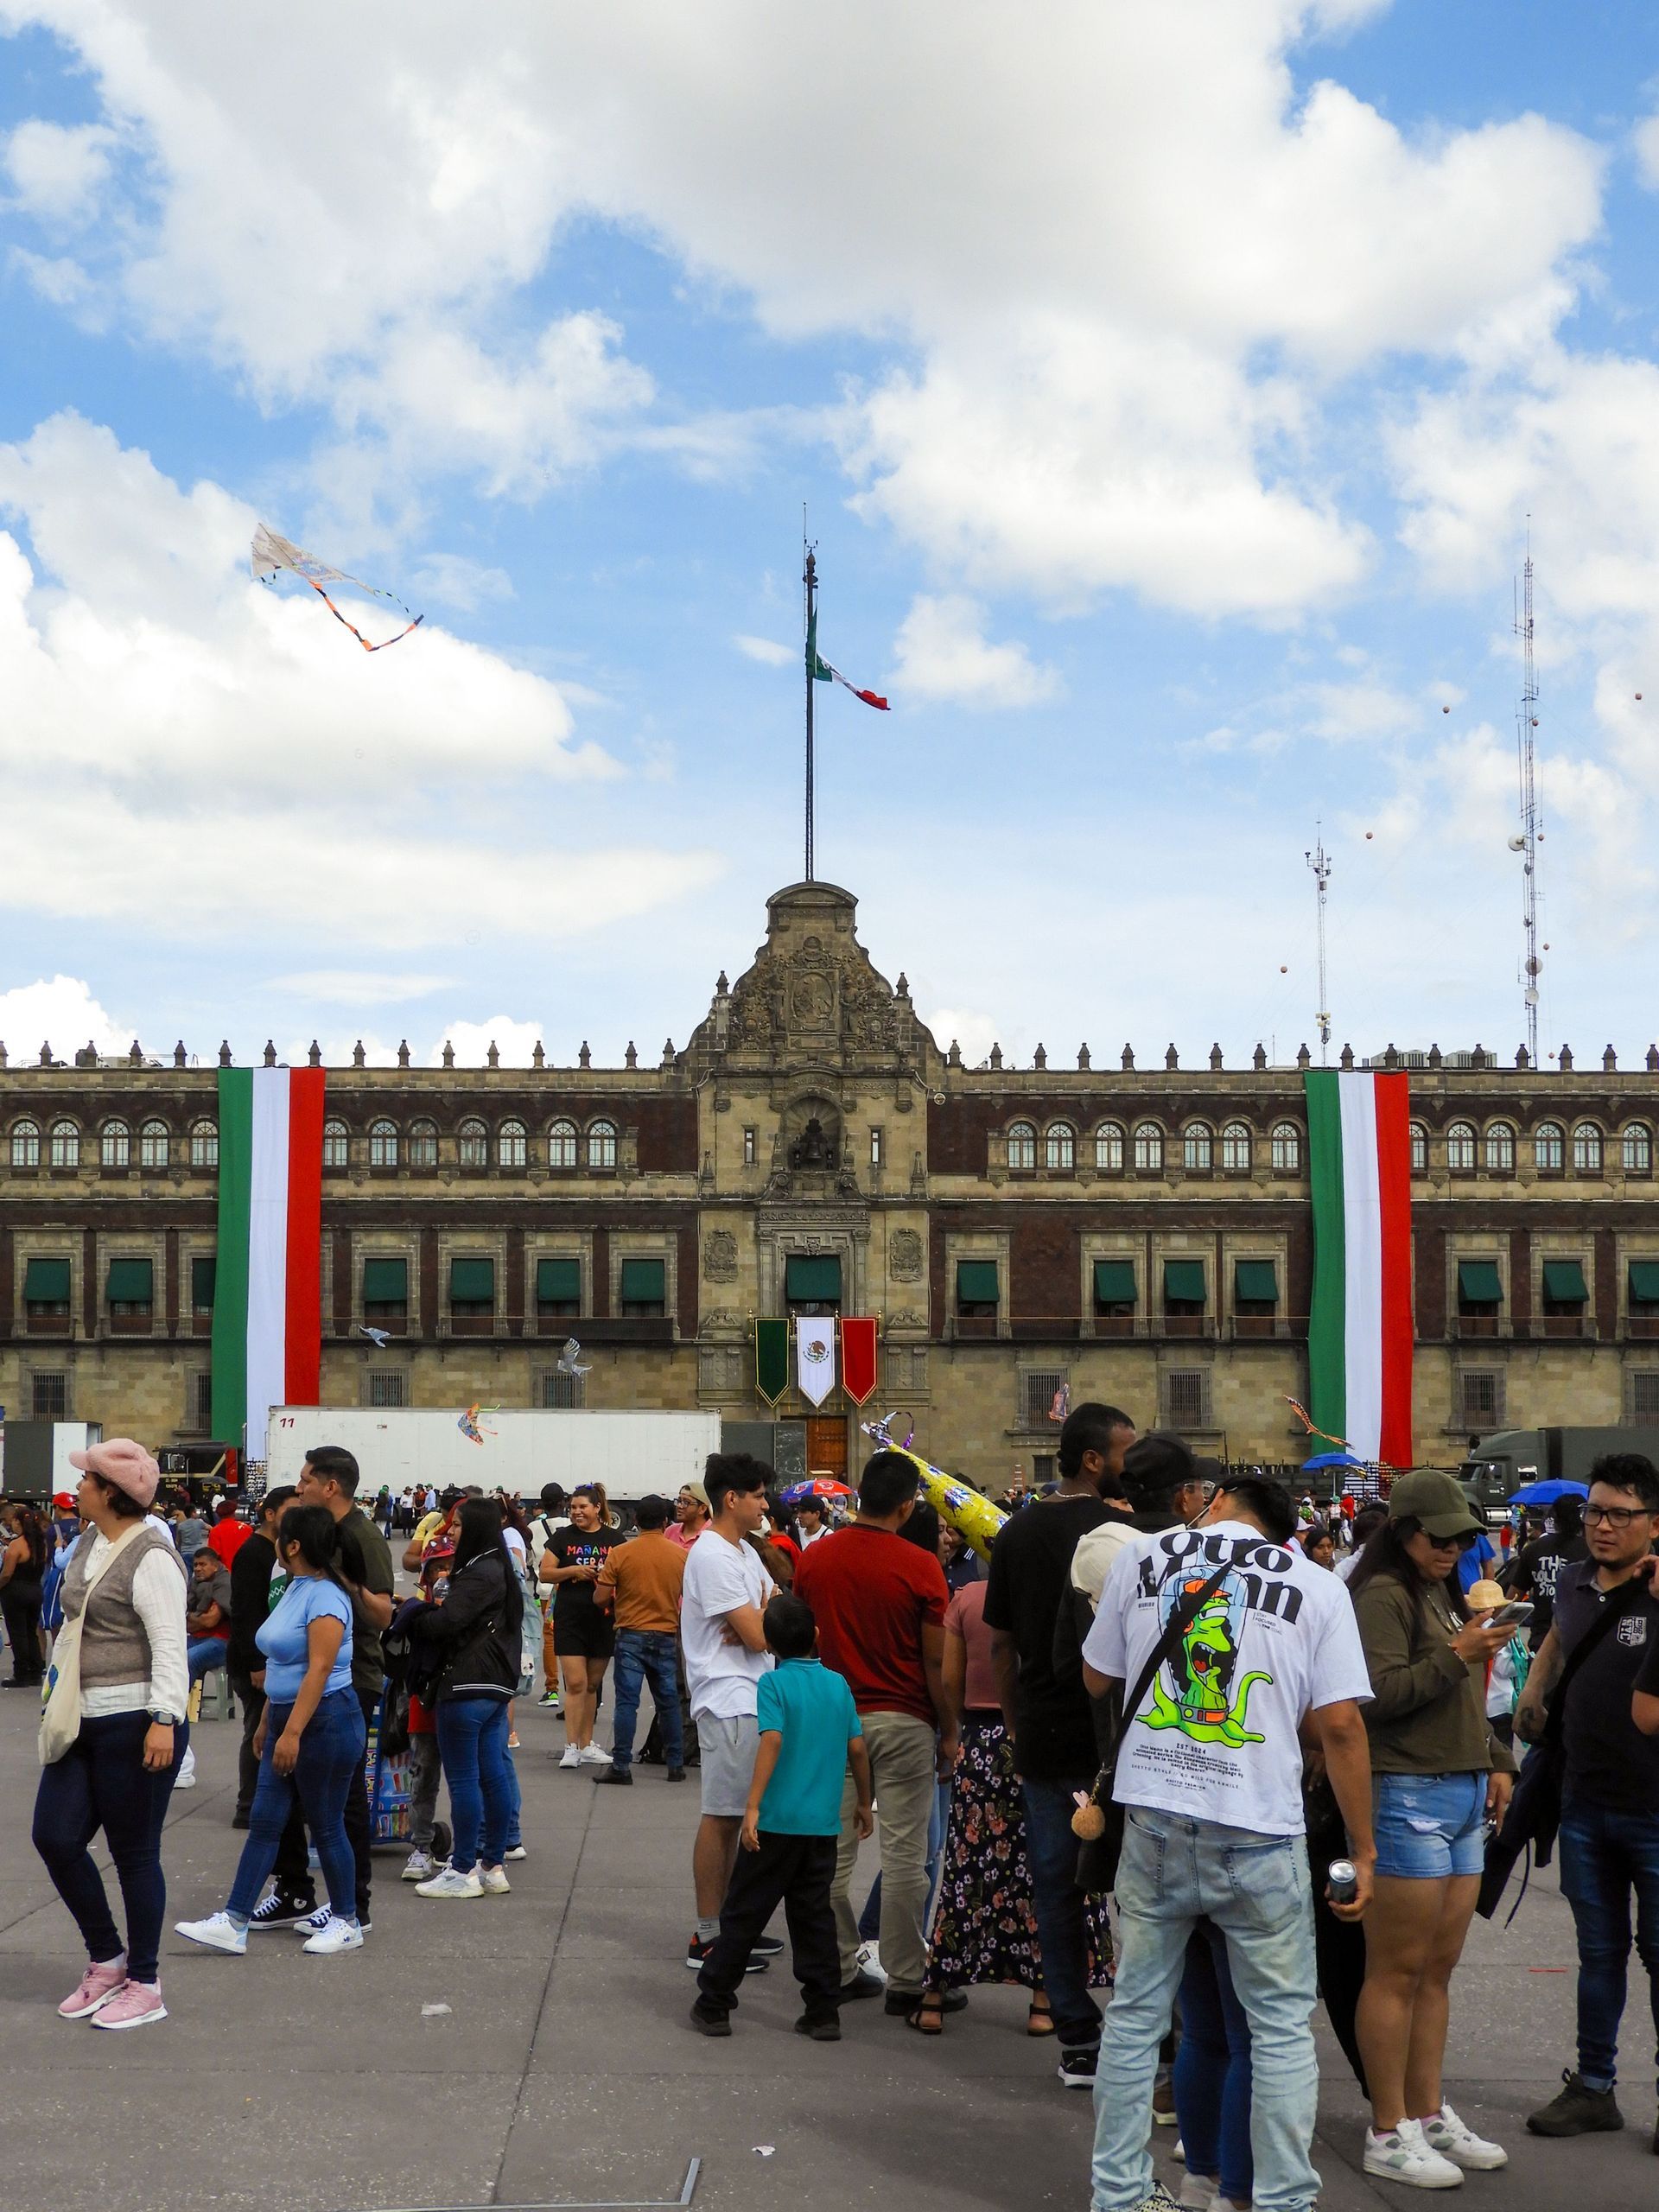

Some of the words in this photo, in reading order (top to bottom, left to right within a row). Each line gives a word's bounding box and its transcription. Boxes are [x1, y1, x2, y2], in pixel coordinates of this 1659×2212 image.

[280, 1418, 295, 1427] 11
[1160, 1531, 1293, 1573] Otto
[1538, 1555, 1568, 1571] THE
[1137, 1555, 1303, 1624] Mnn
[1539, 1581, 1556, 1596] STO
[1255, 1617, 1276, 1627] FOCUSED
